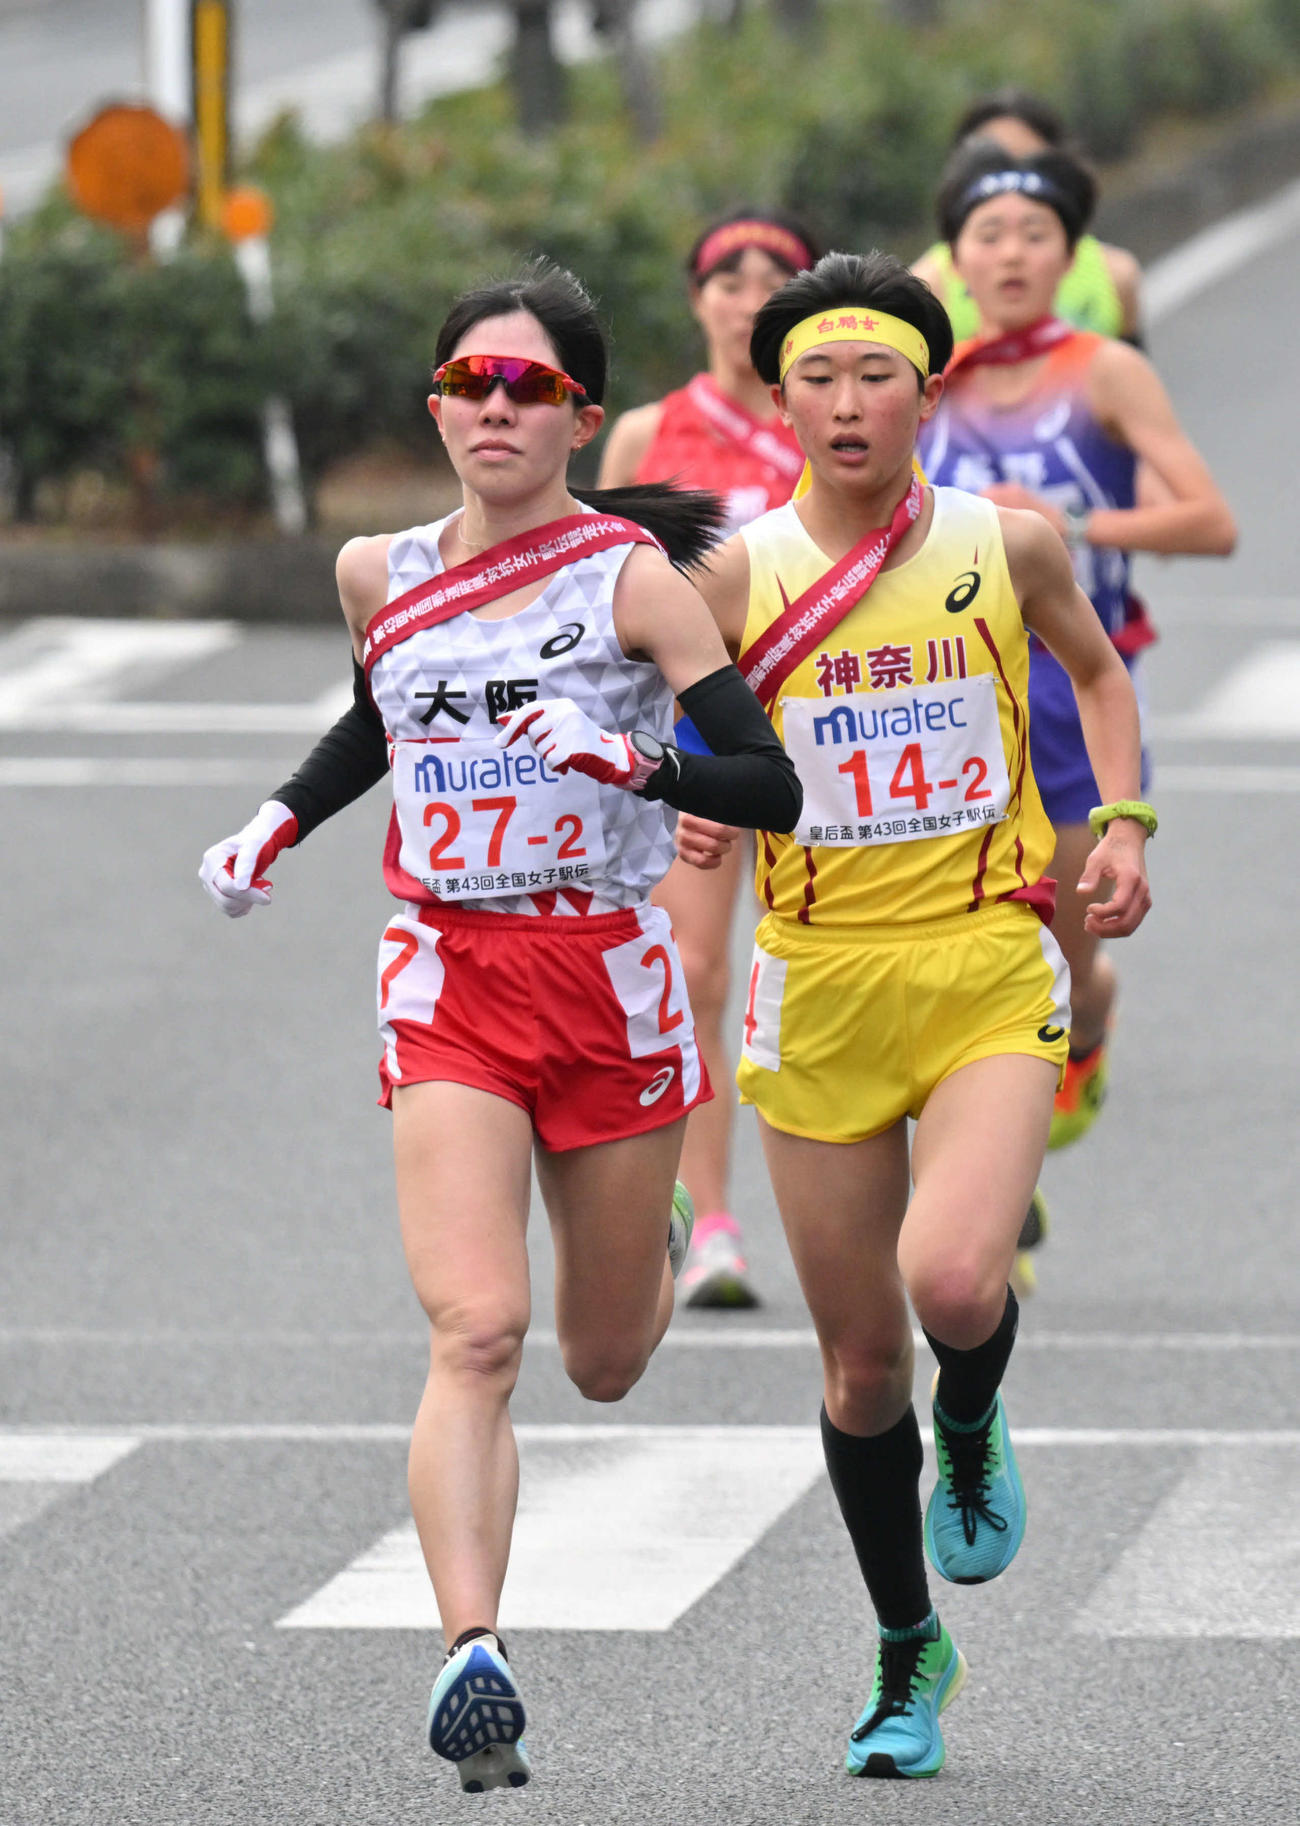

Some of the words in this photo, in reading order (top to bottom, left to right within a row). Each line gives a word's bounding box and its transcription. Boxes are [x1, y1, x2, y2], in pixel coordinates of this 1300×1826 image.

[815, 636, 967, 698] 神奈川
[414, 679, 539, 726] 大阪
[813, 698, 967, 746] muratec
[838, 742, 993, 818] 14-2
[423, 795, 587, 871] 27-2
[810, 825, 854, 841] 皇后盃
[858, 803, 997, 840] 第43回全国女子駅伝
[446, 863, 590, 894] 第43回全国女子駅伝
